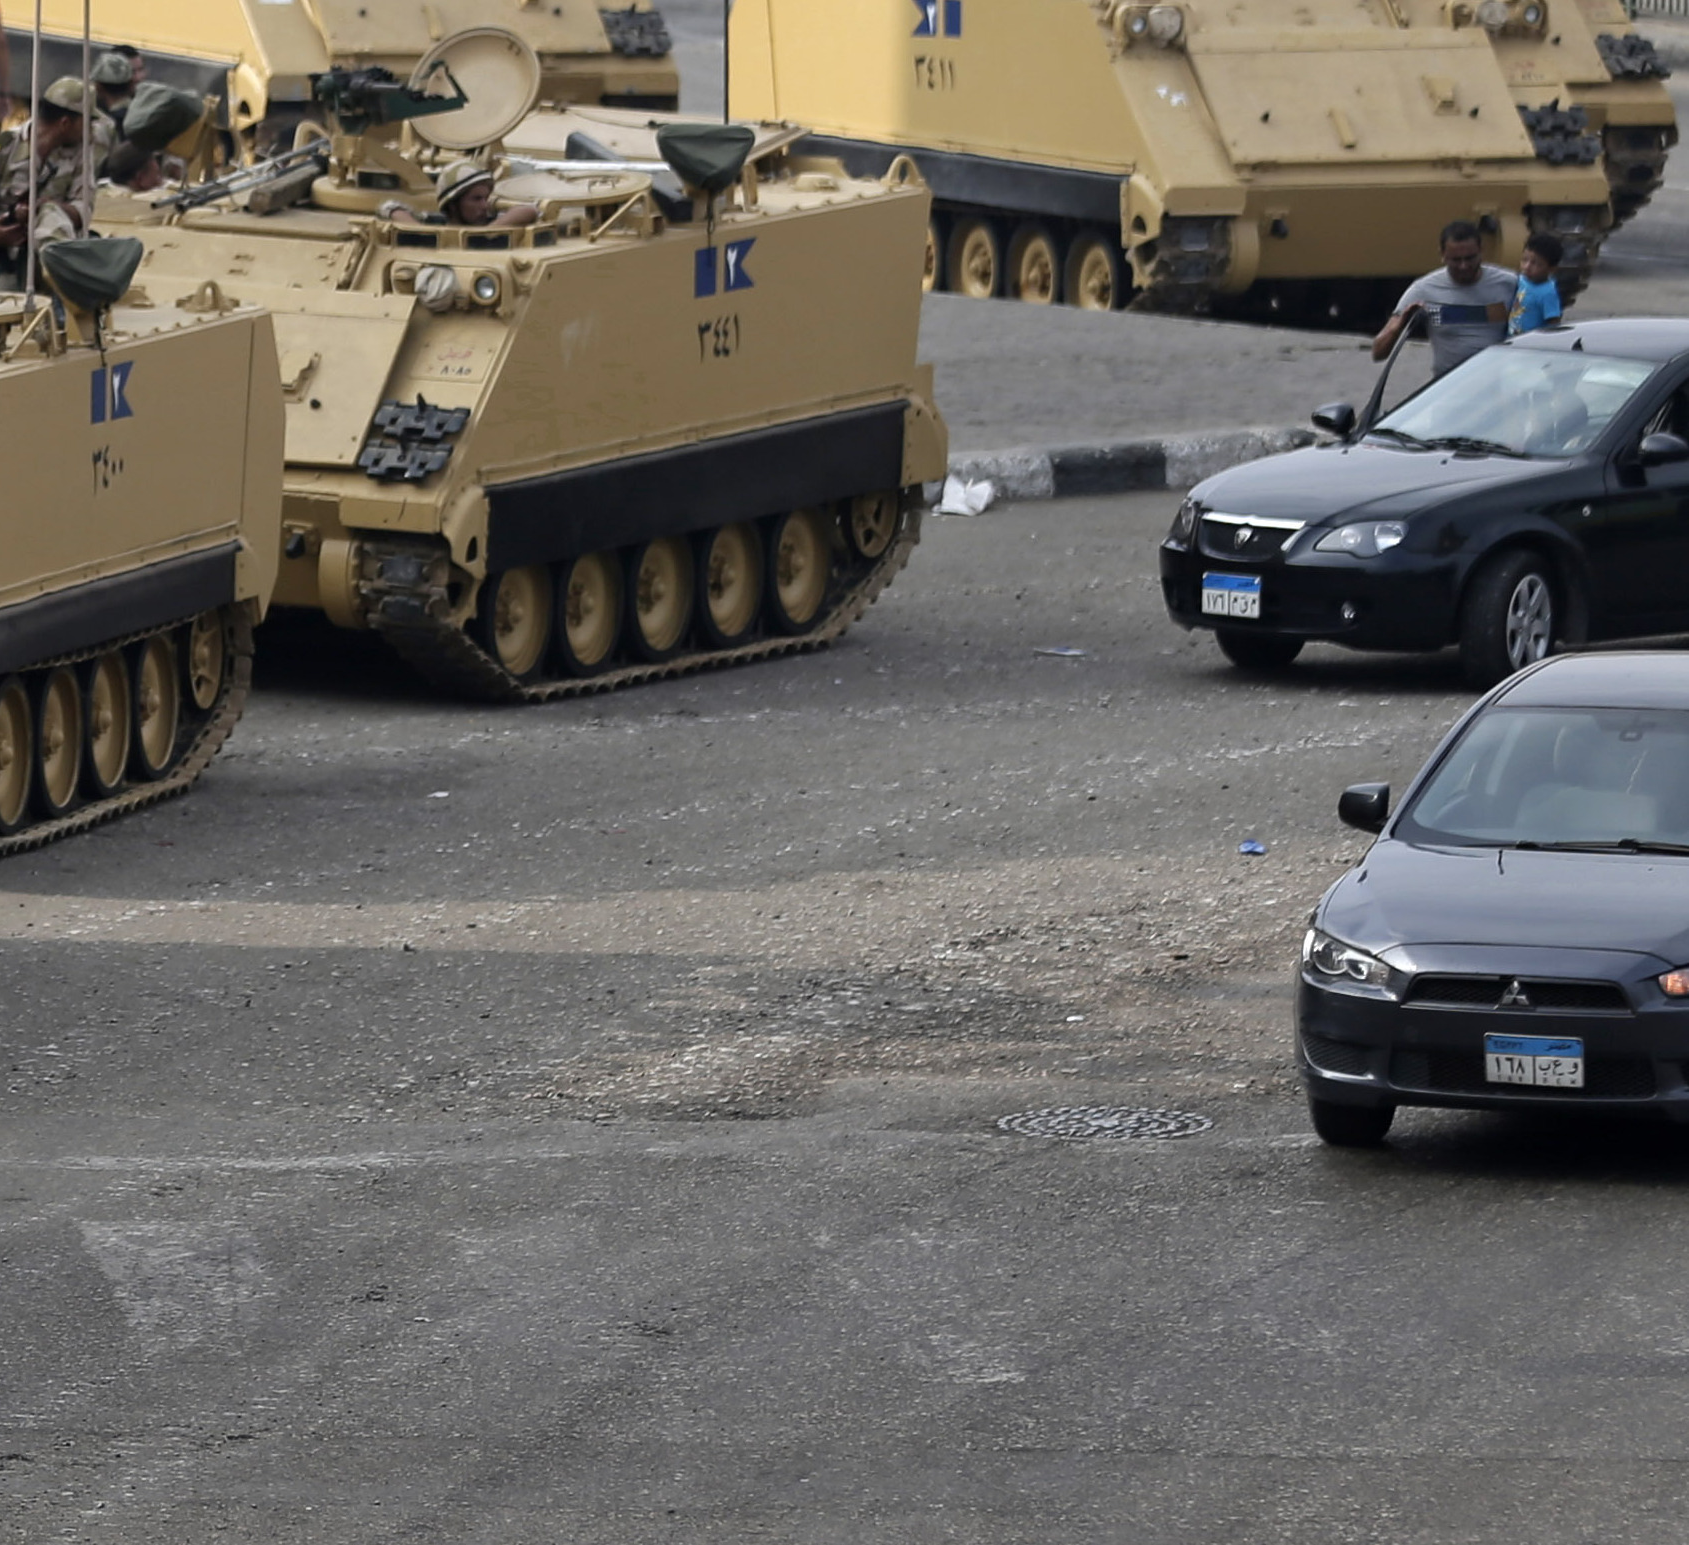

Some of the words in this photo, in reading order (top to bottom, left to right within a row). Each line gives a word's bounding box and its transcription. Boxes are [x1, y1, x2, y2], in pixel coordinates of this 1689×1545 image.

[914, 55, 954, 91] ٣٤١١
[697, 314, 740, 364] ٣٤٤١
[1495, 1056, 1526, 1074] ١٦٨
